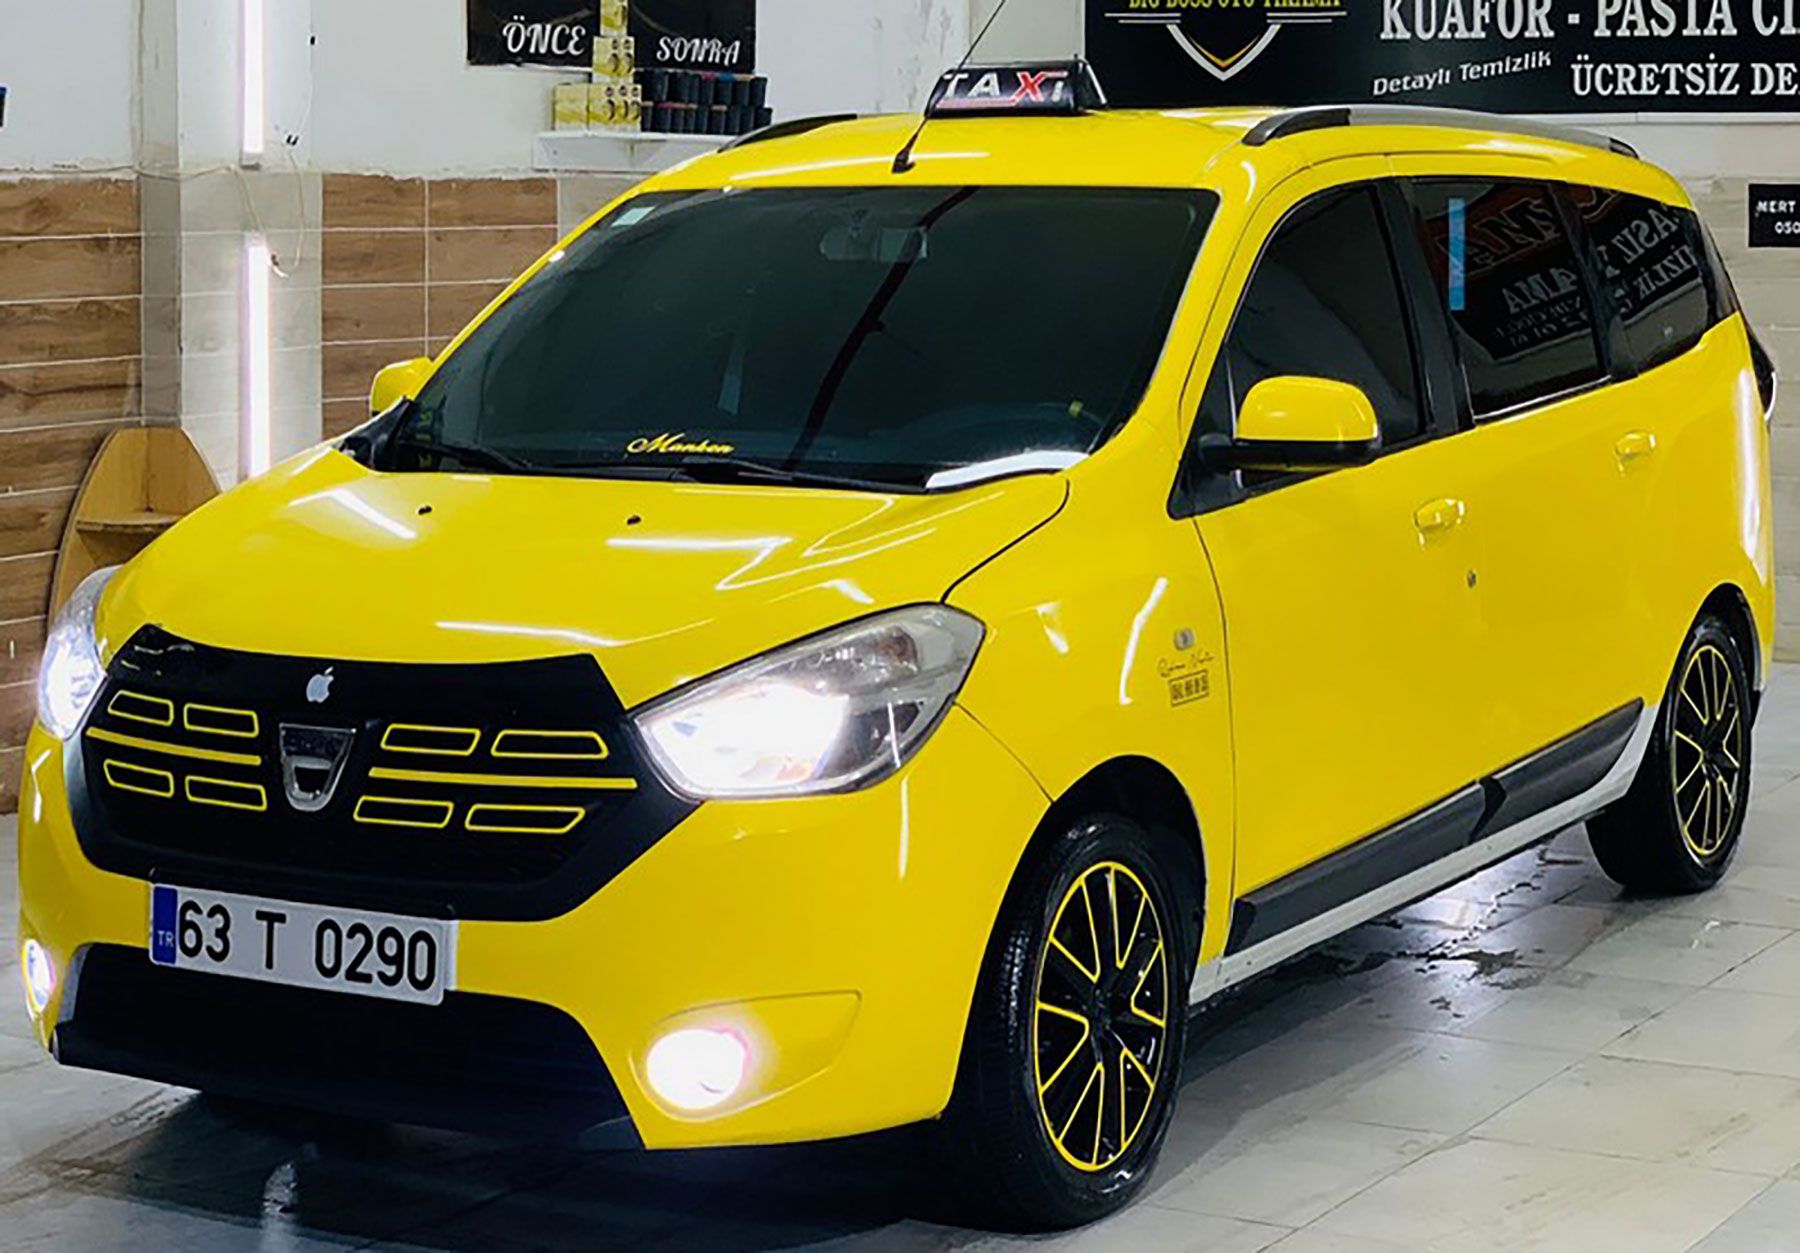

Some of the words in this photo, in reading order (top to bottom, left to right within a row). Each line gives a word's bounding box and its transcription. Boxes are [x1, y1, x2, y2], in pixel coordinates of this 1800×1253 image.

[502, 15, 587, 56] ÖNCE
[1593, 0, 1738, 37] PASTA
[656, 37, 741, 66] SONRA
[1373, 66, 1451, 97] Detaylı
[1459, 50, 1551, 82] Temizlik
[1570, 52, 1740, 96] ÜCRETSİZ
[1750, 62, 1800, 96] DE
[157, 930, 175, 948] TR
[178, 899, 232, 962] 63
[255, 909, 287, 971] T
[314, 918, 437, 992] 0290
